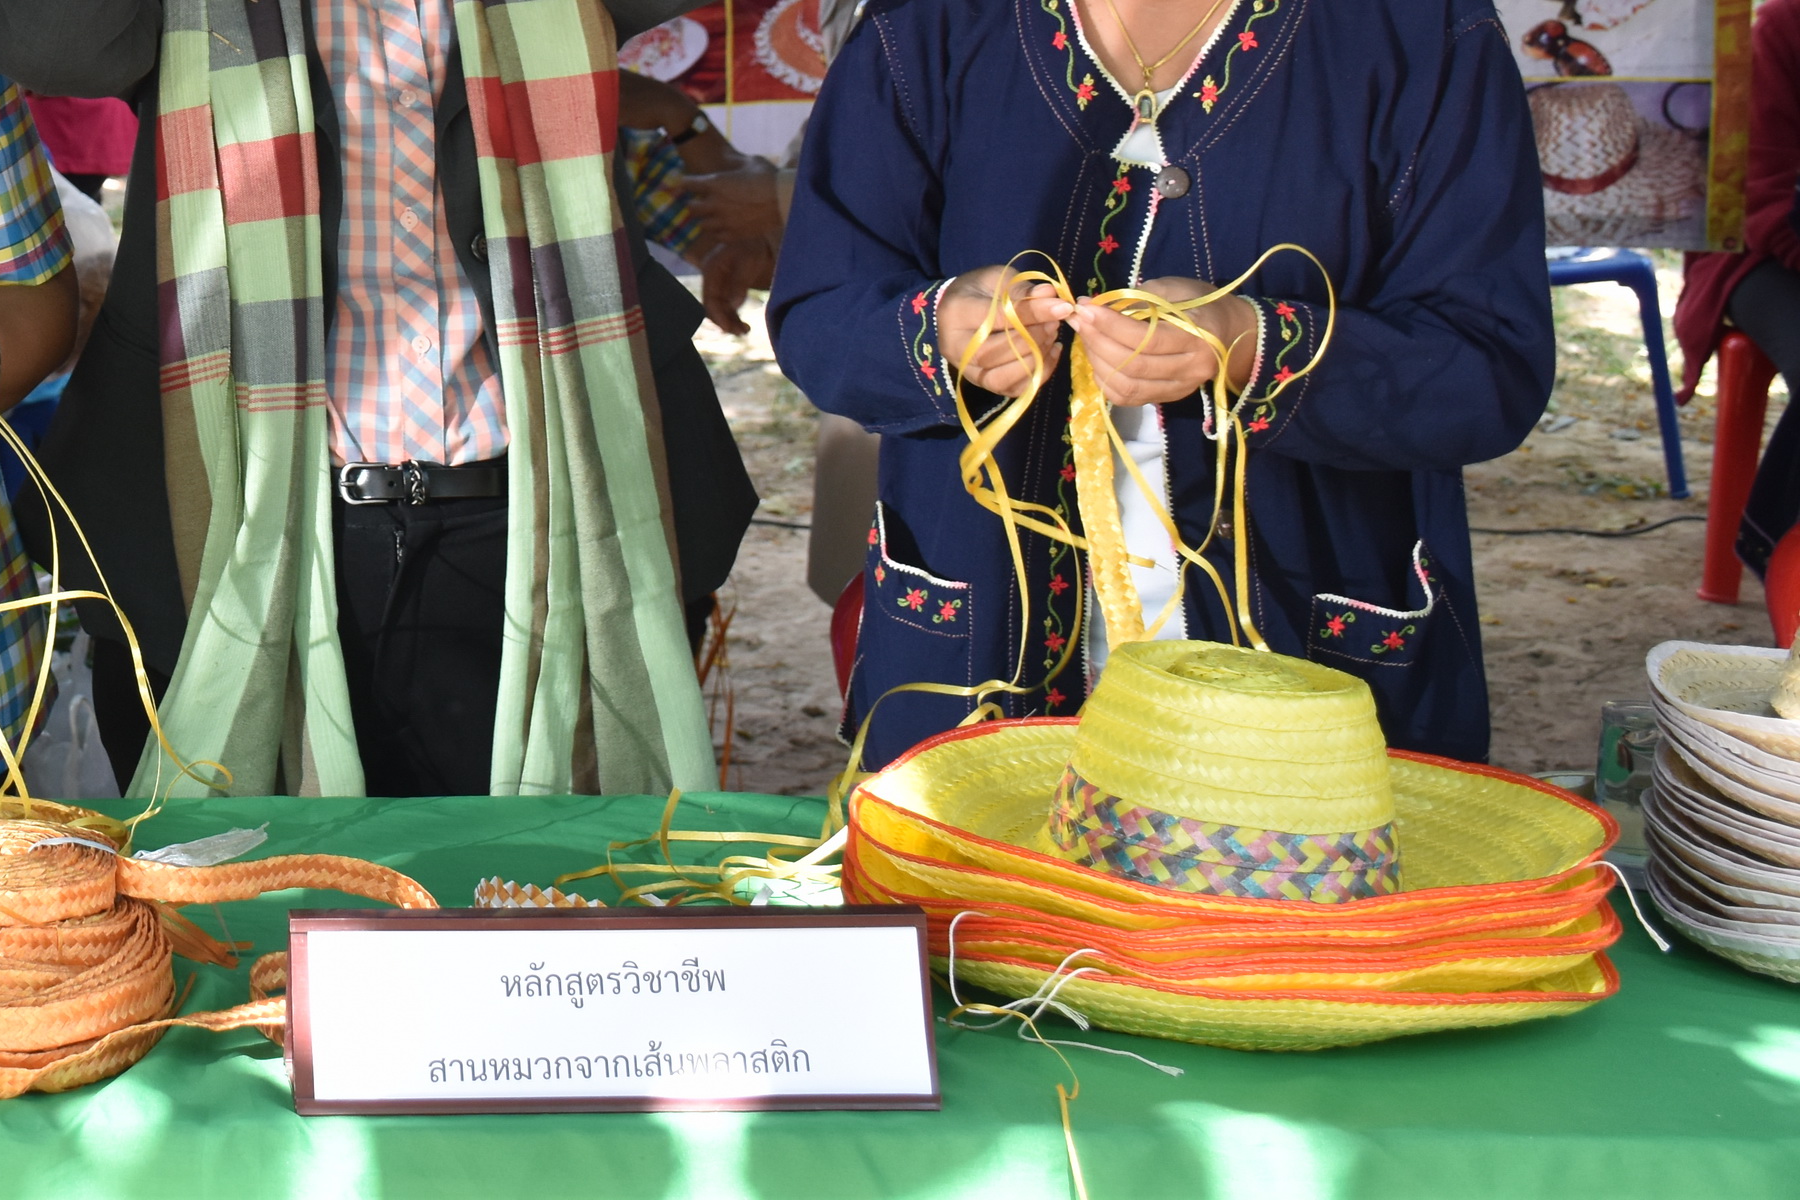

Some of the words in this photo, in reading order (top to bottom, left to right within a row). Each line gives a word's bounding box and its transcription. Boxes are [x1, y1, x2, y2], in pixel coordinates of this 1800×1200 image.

[499, 956, 727, 1009] หลักสูตรวิชาชีพ
[427, 1038, 812, 1083] สานหมวกจากเส้นพลาสติก
